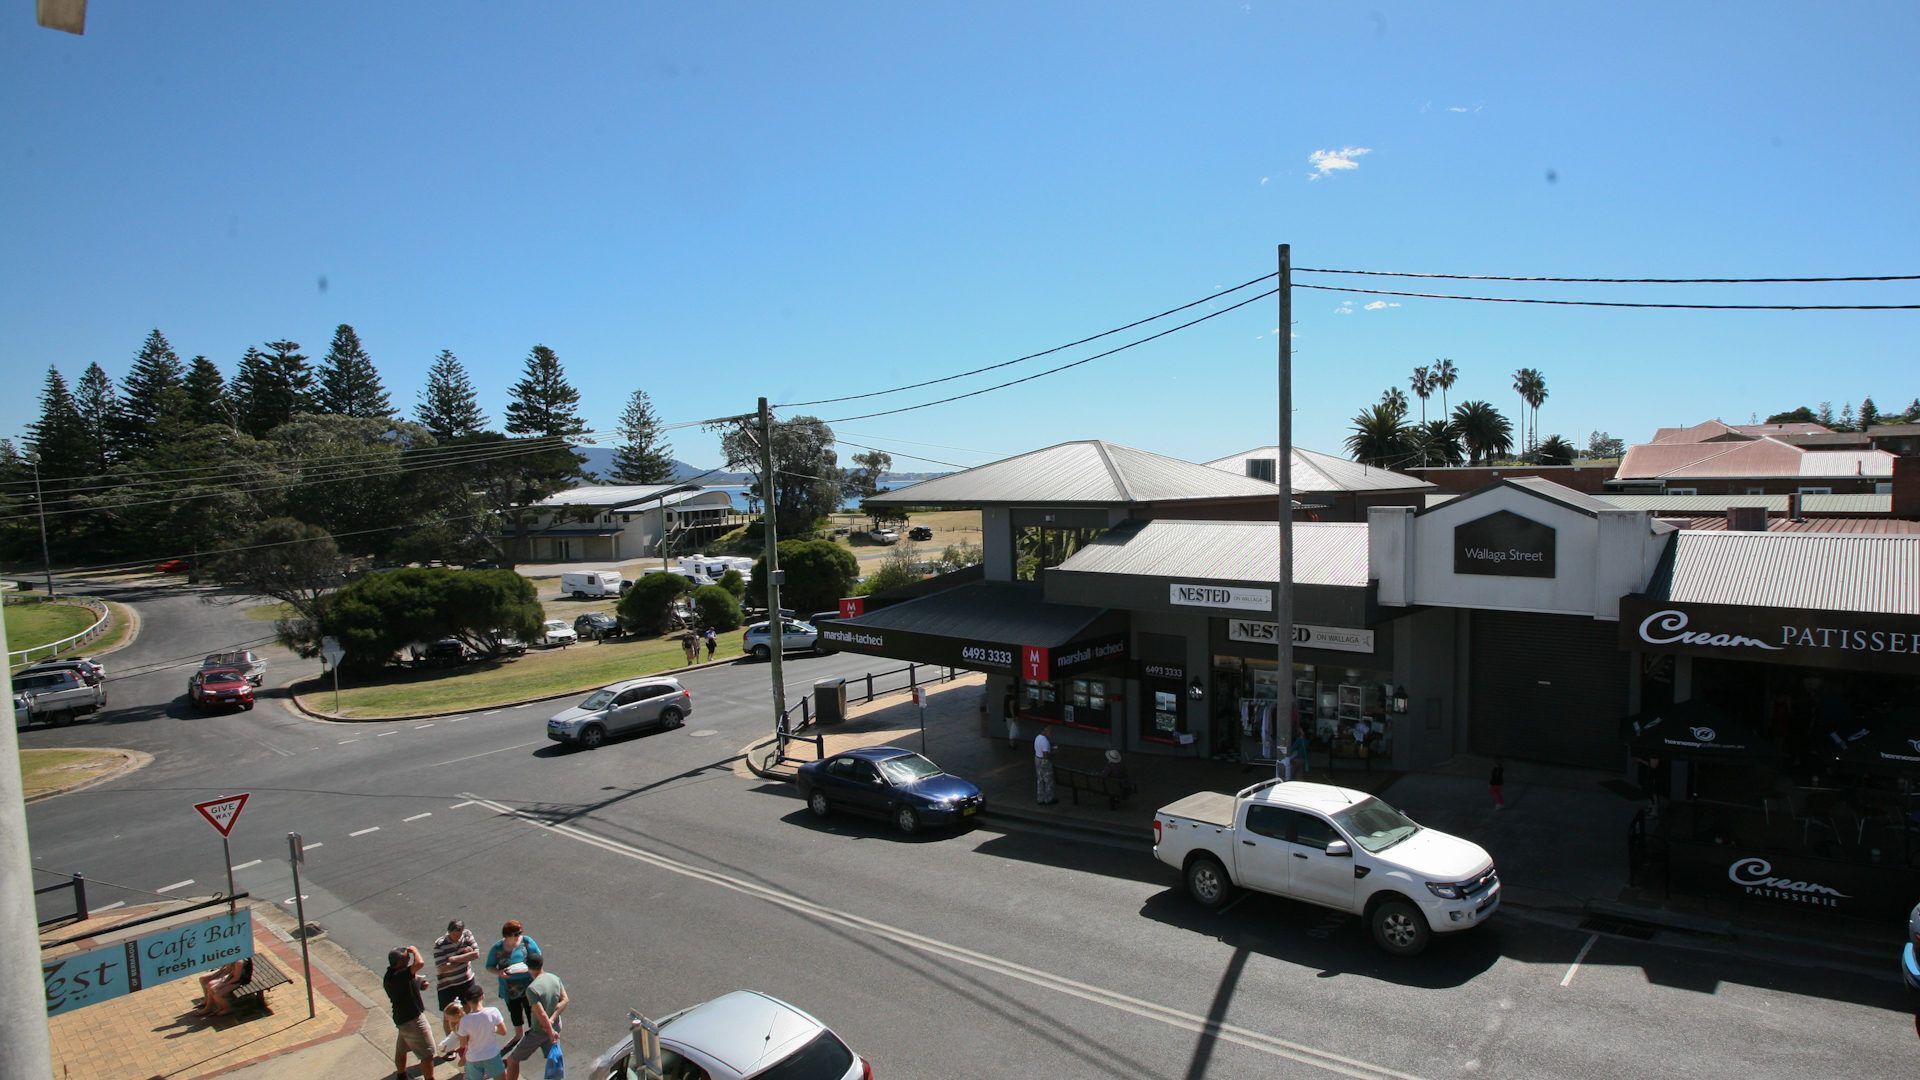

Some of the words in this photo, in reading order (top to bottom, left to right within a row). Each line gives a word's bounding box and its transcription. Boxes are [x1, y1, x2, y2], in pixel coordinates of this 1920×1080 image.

[1465, 547, 1506, 563] Wallaga
[1509, 548, 1543, 562] Street
[1178, 587, 1231, 604] NESTED
[847, 602, 856, 611] M
[1239, 622, 1311, 642] NESED
[1638, 609, 1785, 650] Cream
[823, 630, 883, 647] marshall+tacheci
[1316, 633, 1326, 641] ON
[1328, 634, 1359, 644] WALLAGA
[962, 646, 986, 660] 6493
[987, 649, 1012, 664] 3333
[1029, 650, 1040, 663] M
[1031, 664, 1039, 676] T
[1145, 665, 1164, 675] 6493
[1164, 667, 1182, 677] 3333
[211, 803, 235, 814] GIVE
[215, 812, 232, 820] WAY
[1728, 857, 1854, 899] Cream
[1745, 886, 1838, 907] PATISSERIE
[147, 929, 197, 962] Café
[203, 922, 246, 944] Bar
[157, 958, 196, 977] Fresh
[200, 945, 241, 965] Juices
